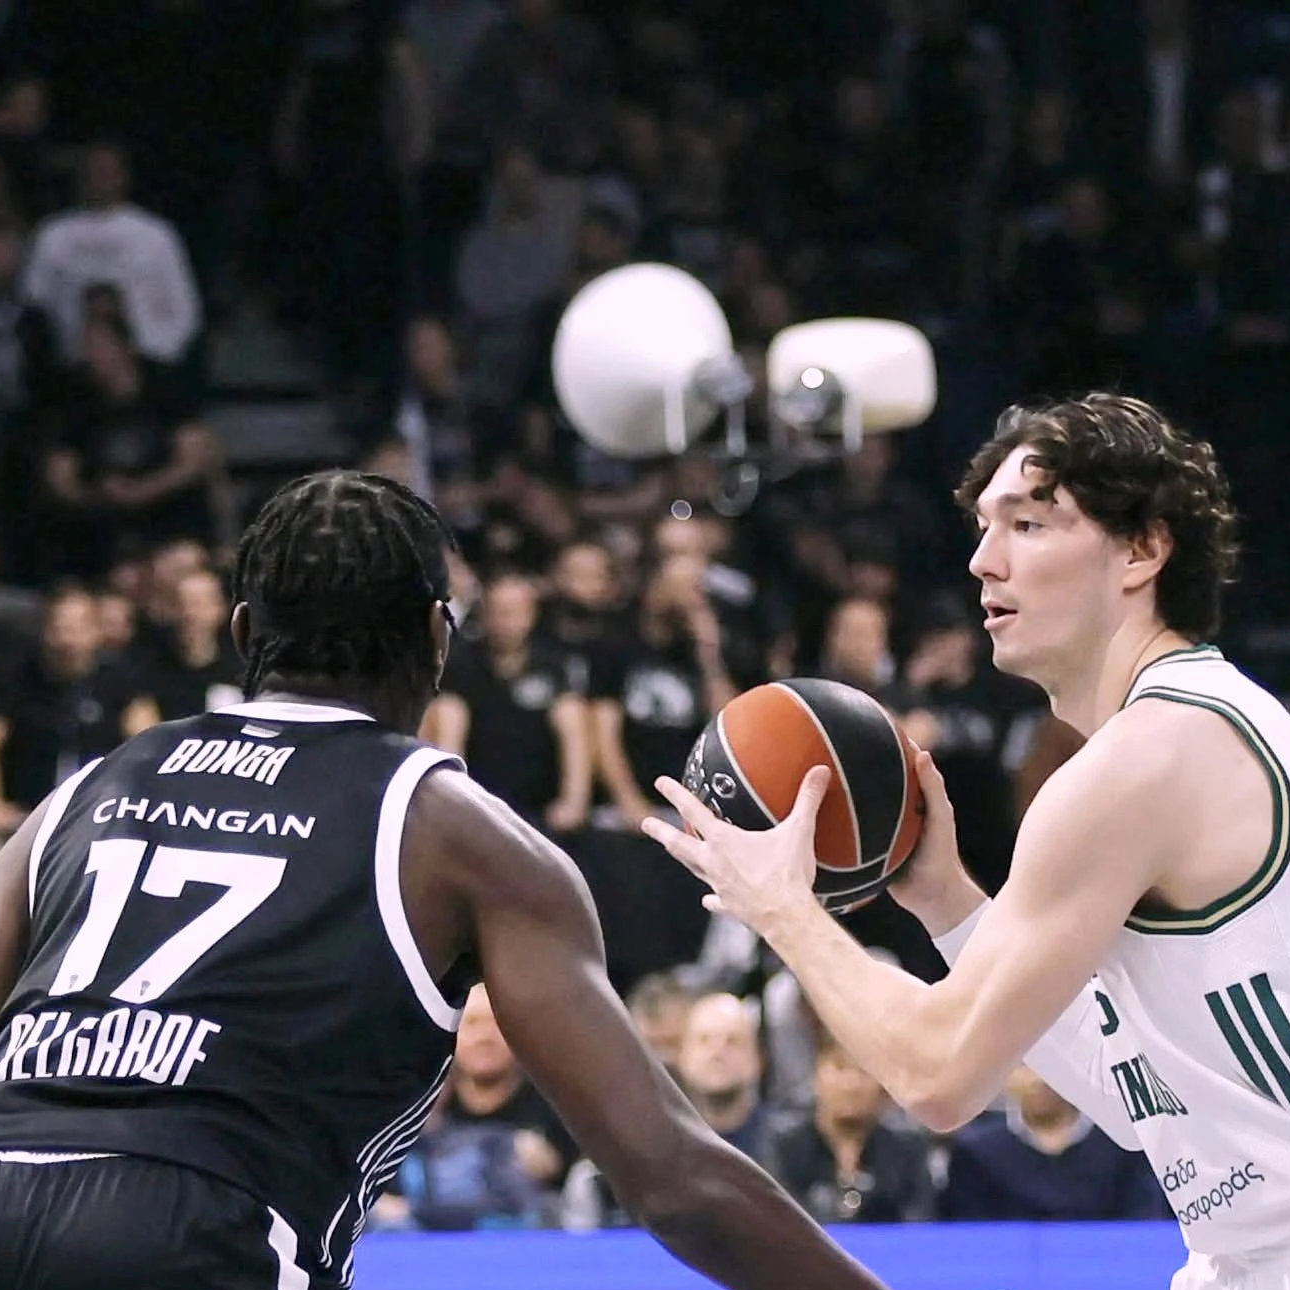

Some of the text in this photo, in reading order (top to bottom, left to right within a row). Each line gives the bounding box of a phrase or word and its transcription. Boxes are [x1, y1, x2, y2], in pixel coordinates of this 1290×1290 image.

[156, 738, 296, 786] BONGA
[92, 796, 317, 840] CHANGAN
[48, 837, 288, 1005] 17
